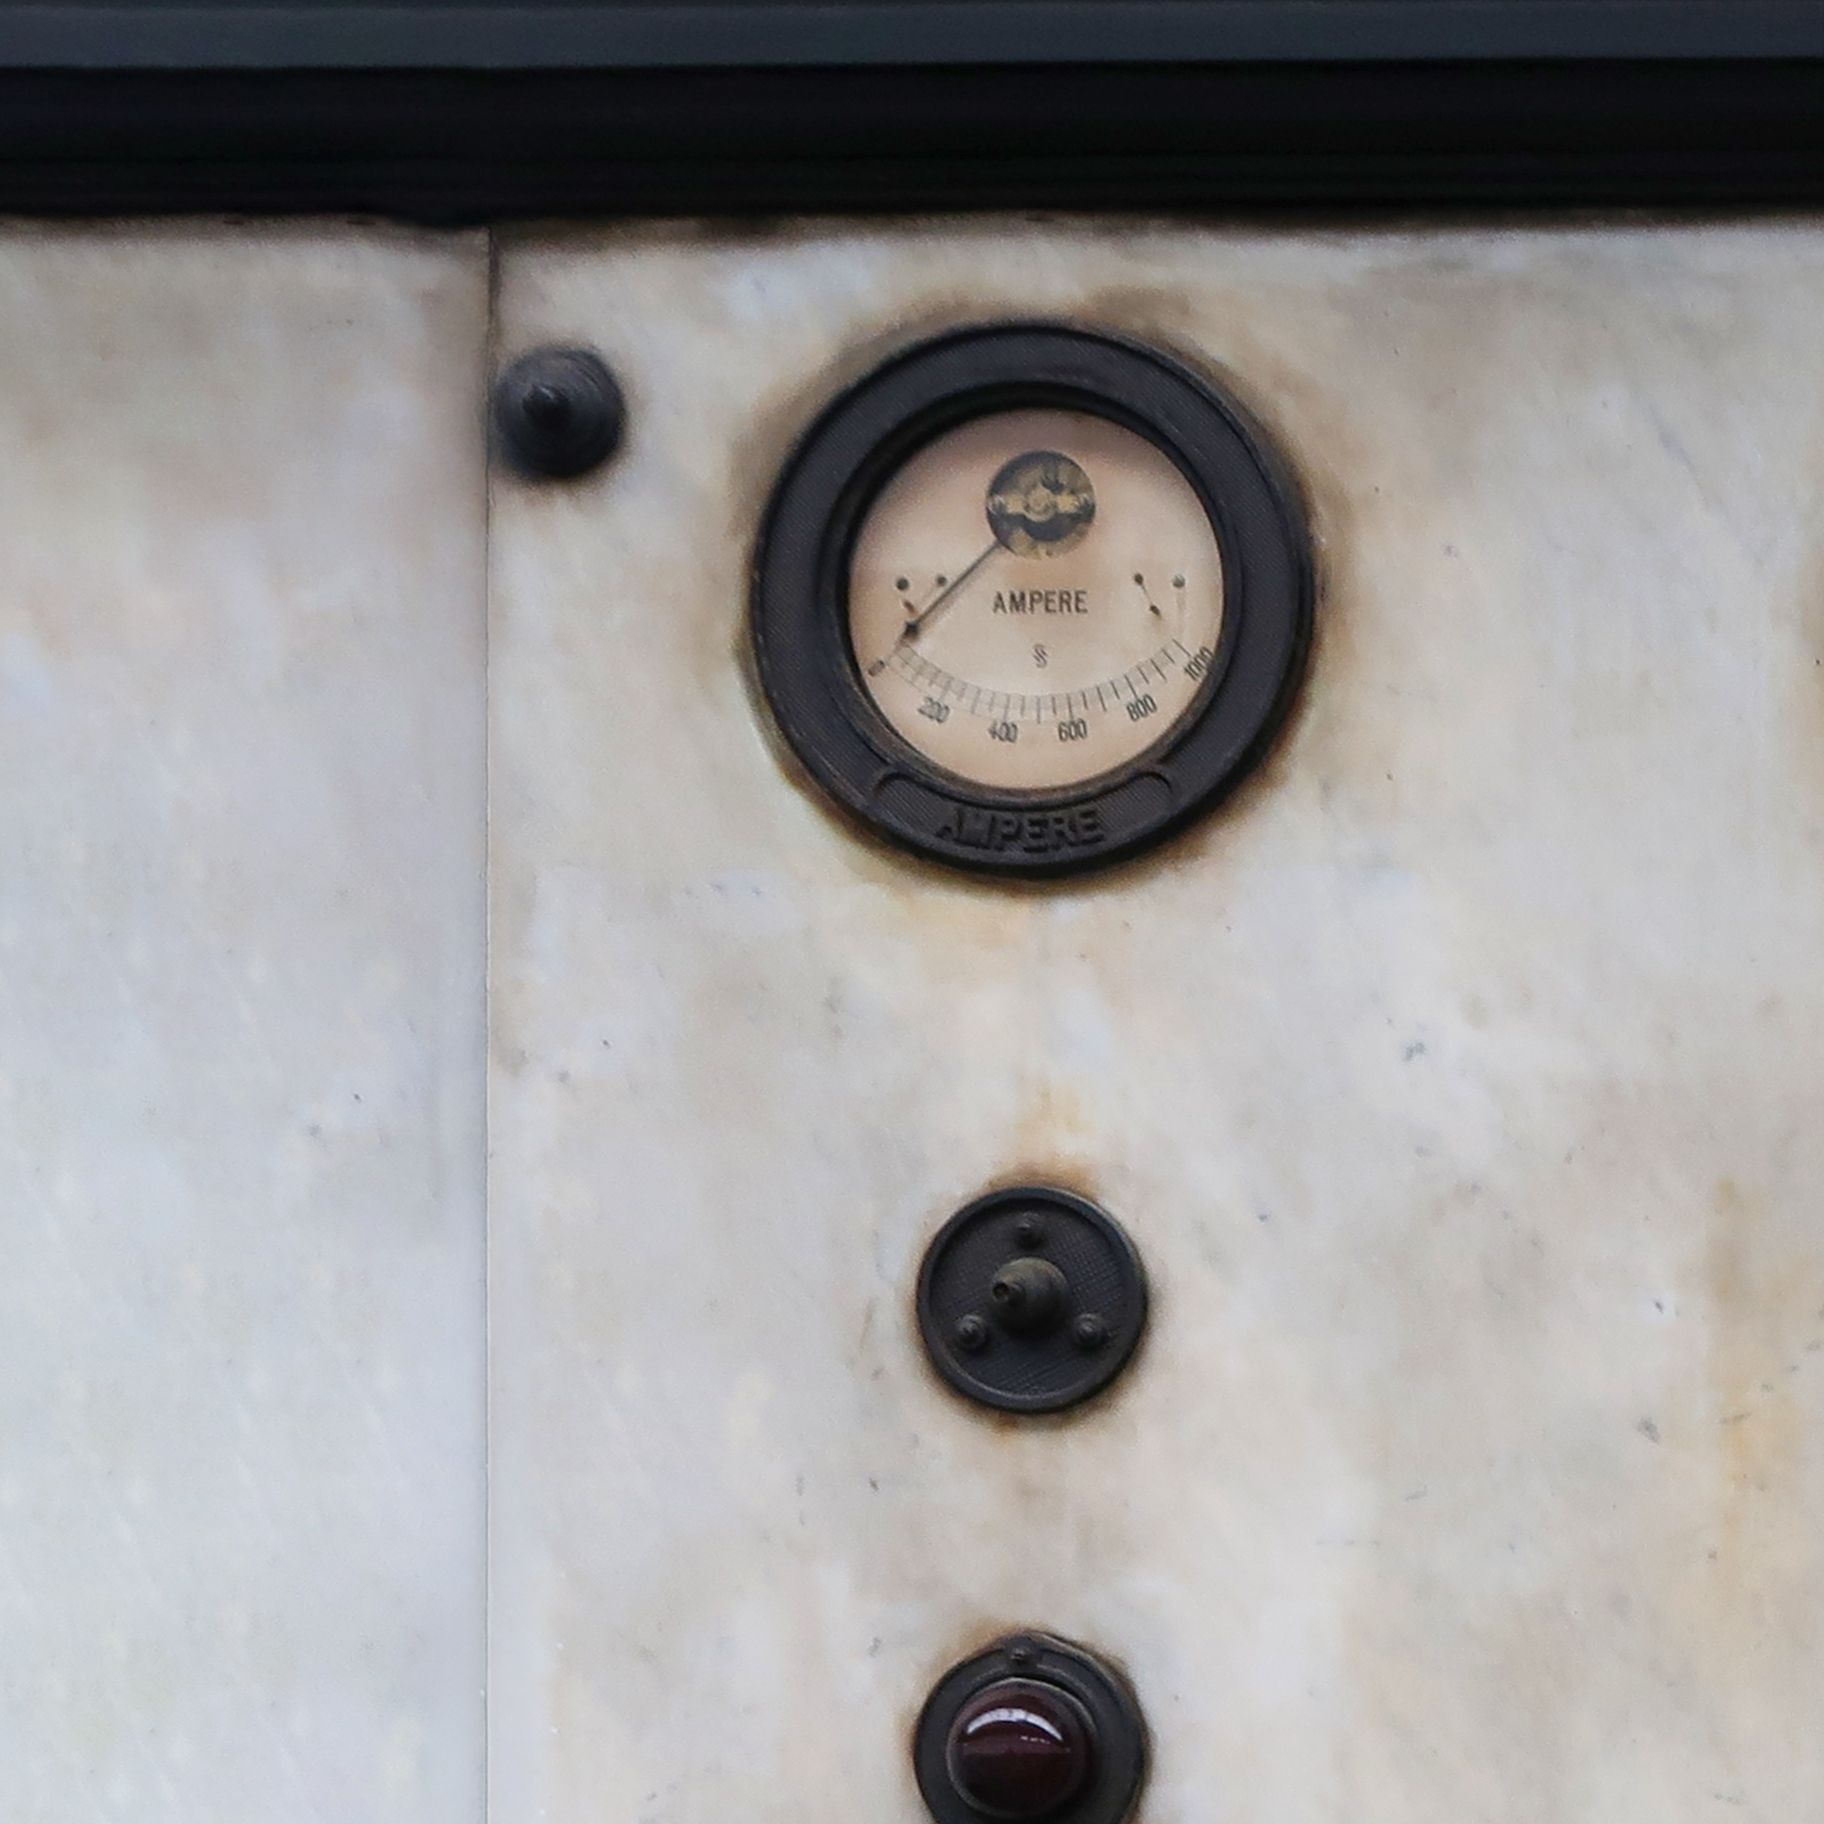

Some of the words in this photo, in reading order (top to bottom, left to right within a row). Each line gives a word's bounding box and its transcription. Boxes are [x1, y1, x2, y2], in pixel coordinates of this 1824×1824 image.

[992, 590, 1088, 615] AMPERE
[918, 697, 949, 725] 200
[988, 722, 1018, 742] 400
[1059, 720, 1087, 740] 600
[1127, 694, 1157, 720] 800
[1183, 647, 1213, 680] 1000
[936, 808, 1106, 853] AMPERE
